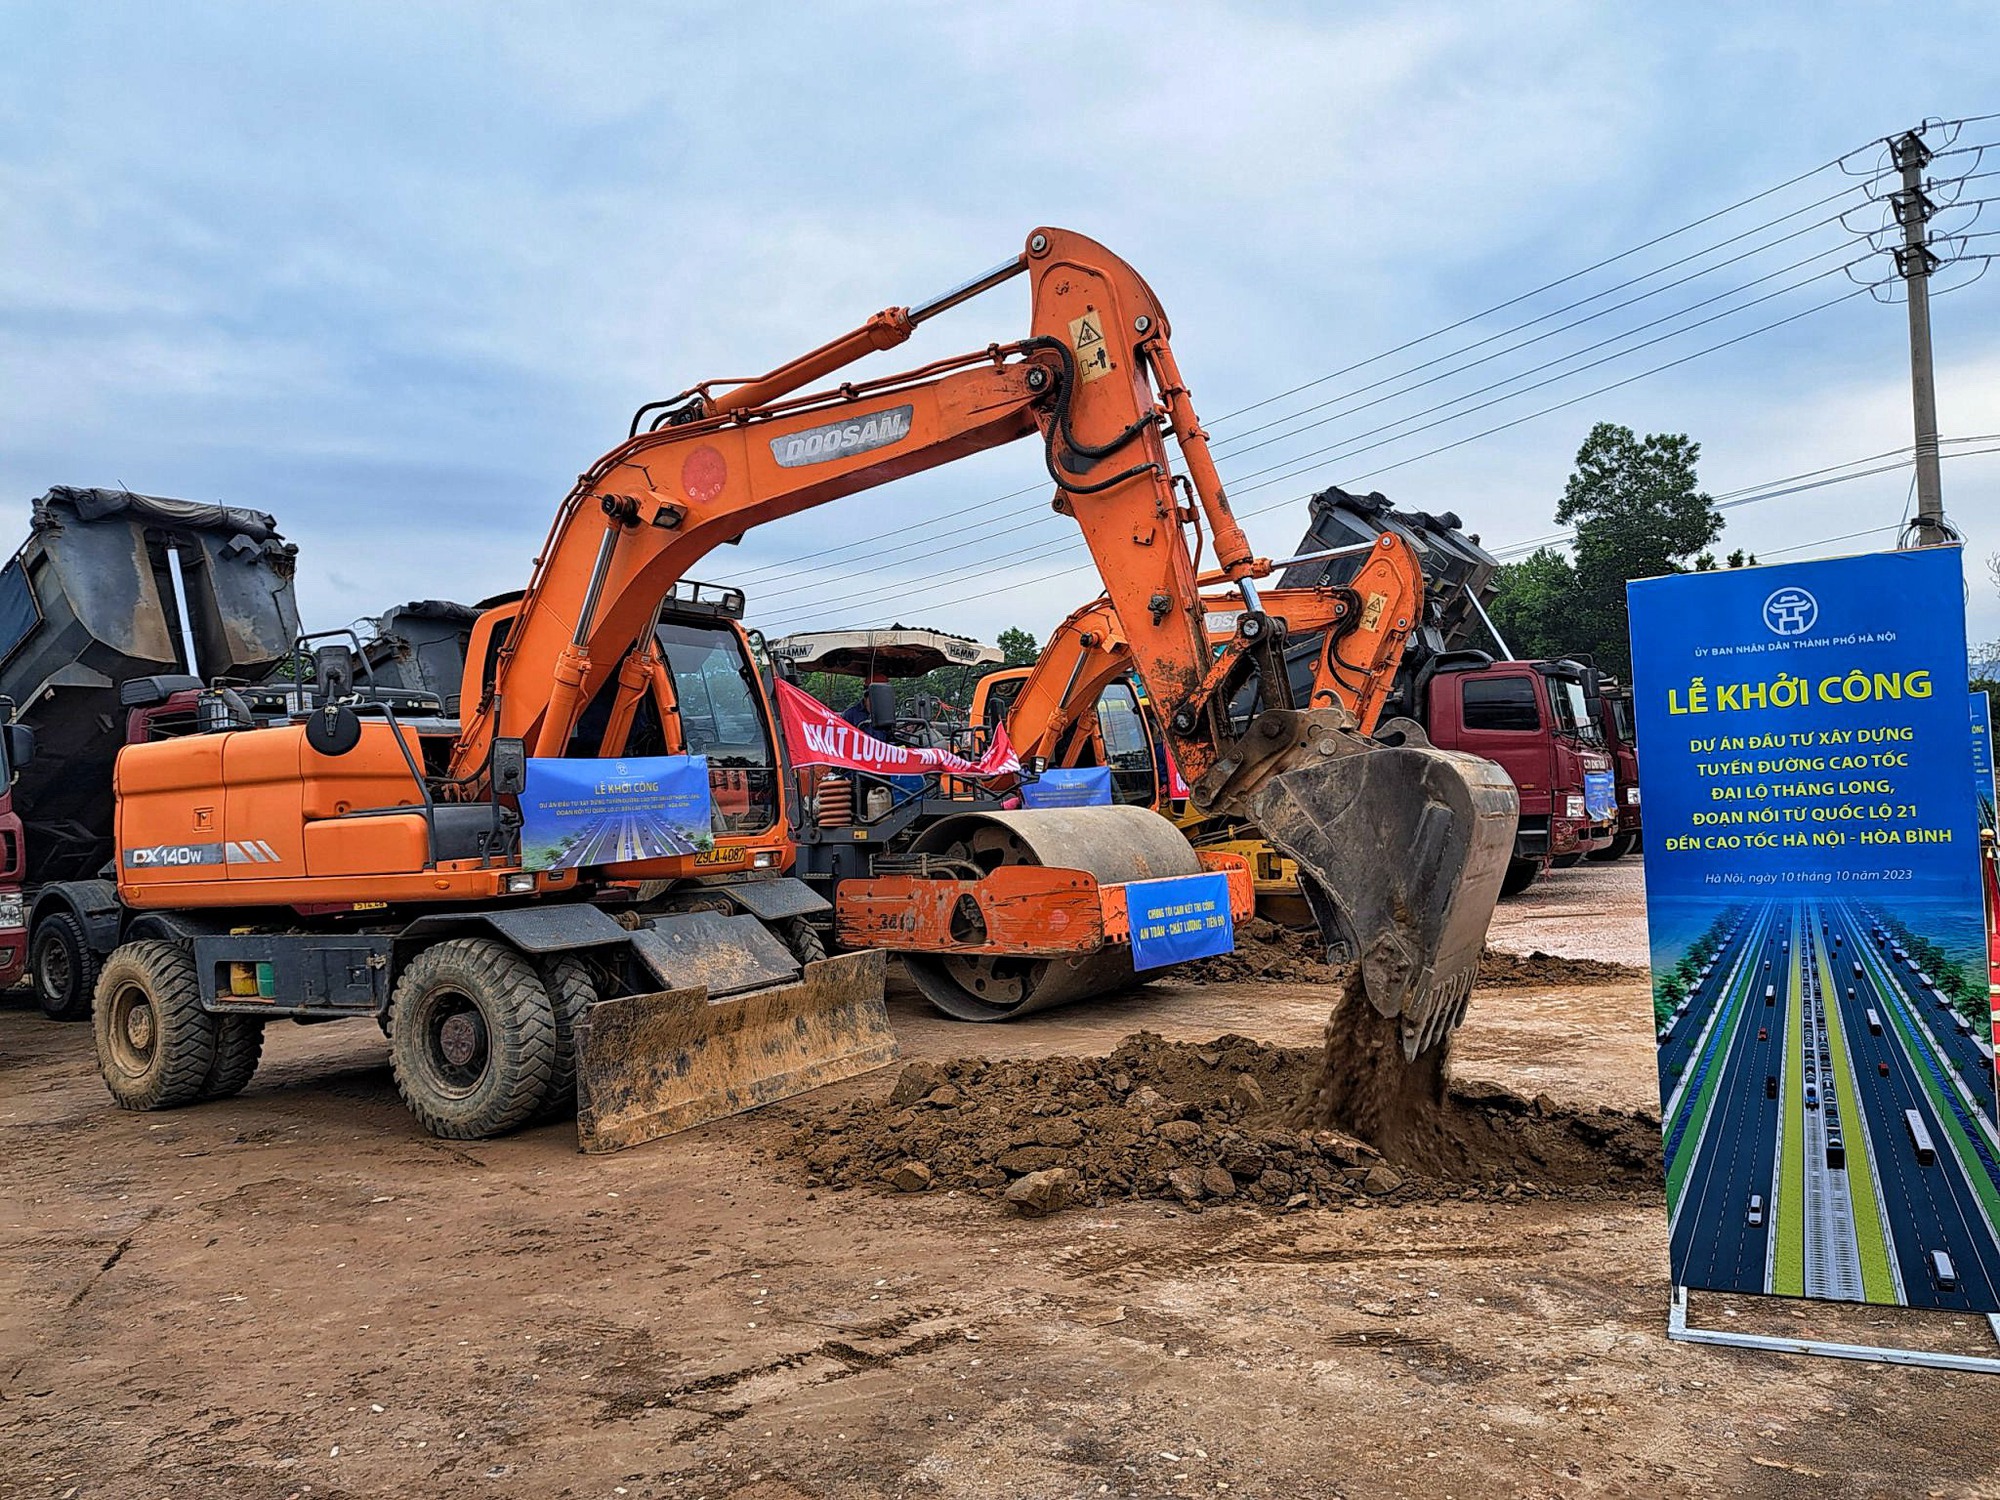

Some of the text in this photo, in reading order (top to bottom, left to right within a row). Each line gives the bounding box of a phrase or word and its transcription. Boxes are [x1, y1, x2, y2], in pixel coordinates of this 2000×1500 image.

[785, 414, 903, 461] DOOSAN
[949, 645, 975, 659] HAMM
[1694, 631, 1897, 657] ỦY BAN NHÂN DÂN THÀNH PHỐ HÀ NỘI
[1668, 669, 1933, 715] LỄ KHỞI CÔNG
[1690, 727, 1914, 755] DỰ ÁN ĐẦU TƯ XÂY DỰNG
[1696, 750, 1908, 776] TUYẾN ĐƯỜNG CAO TỐC
[1711, 780, 1895, 803] ĐẠI LỘ THĂNG LONG,
[1692, 803, 1917, 827] ĐOẠN NỐI TỪ QUỐC LỘ 21
[1666, 834, 1701, 851] ĐẾN
[1704, 836, 1741, 849] CAO
[1743, 831, 1778, 847] TỐC
[1783, 830, 1808, 847] HÀ
[1812, 830, 1845, 848] NỘI
[1860, 828, 1901, 844] HÒA
[1905, 828, 1952, 843] BÌNH
[1705, 869, 1913, 885] Hà Nội, ngày 10 tháng 10 năm 2023
